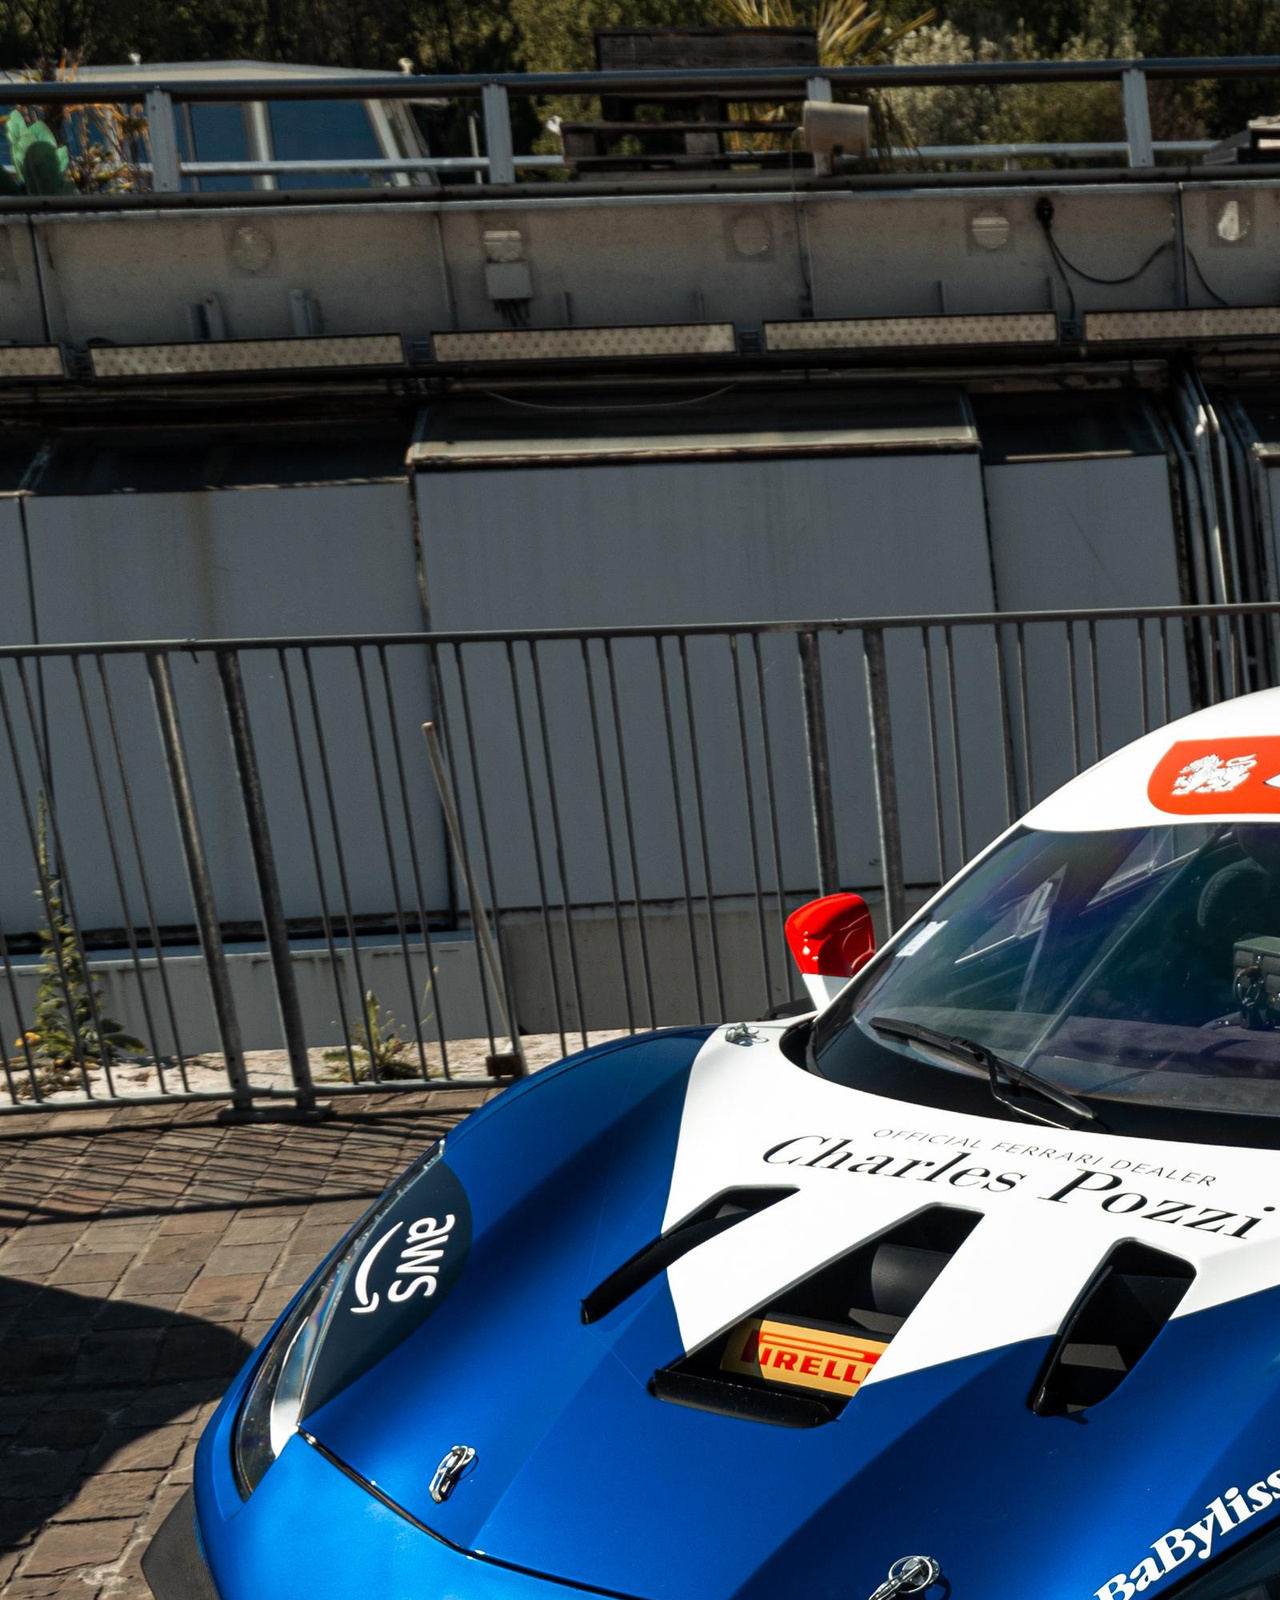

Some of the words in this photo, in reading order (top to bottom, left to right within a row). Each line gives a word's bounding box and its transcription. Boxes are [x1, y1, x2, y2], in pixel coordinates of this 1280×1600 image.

[761, 1134, 1028, 1194] Charles
[1037, 1167, 1277, 1240] Pozzi
[873, 1127, 982, 1150] OFFICIAL
[991, 1142, 1104, 1168] FERRARI
[1109, 1158, 1219, 1187] DEALER
[388, 1214, 456, 1303] aws
